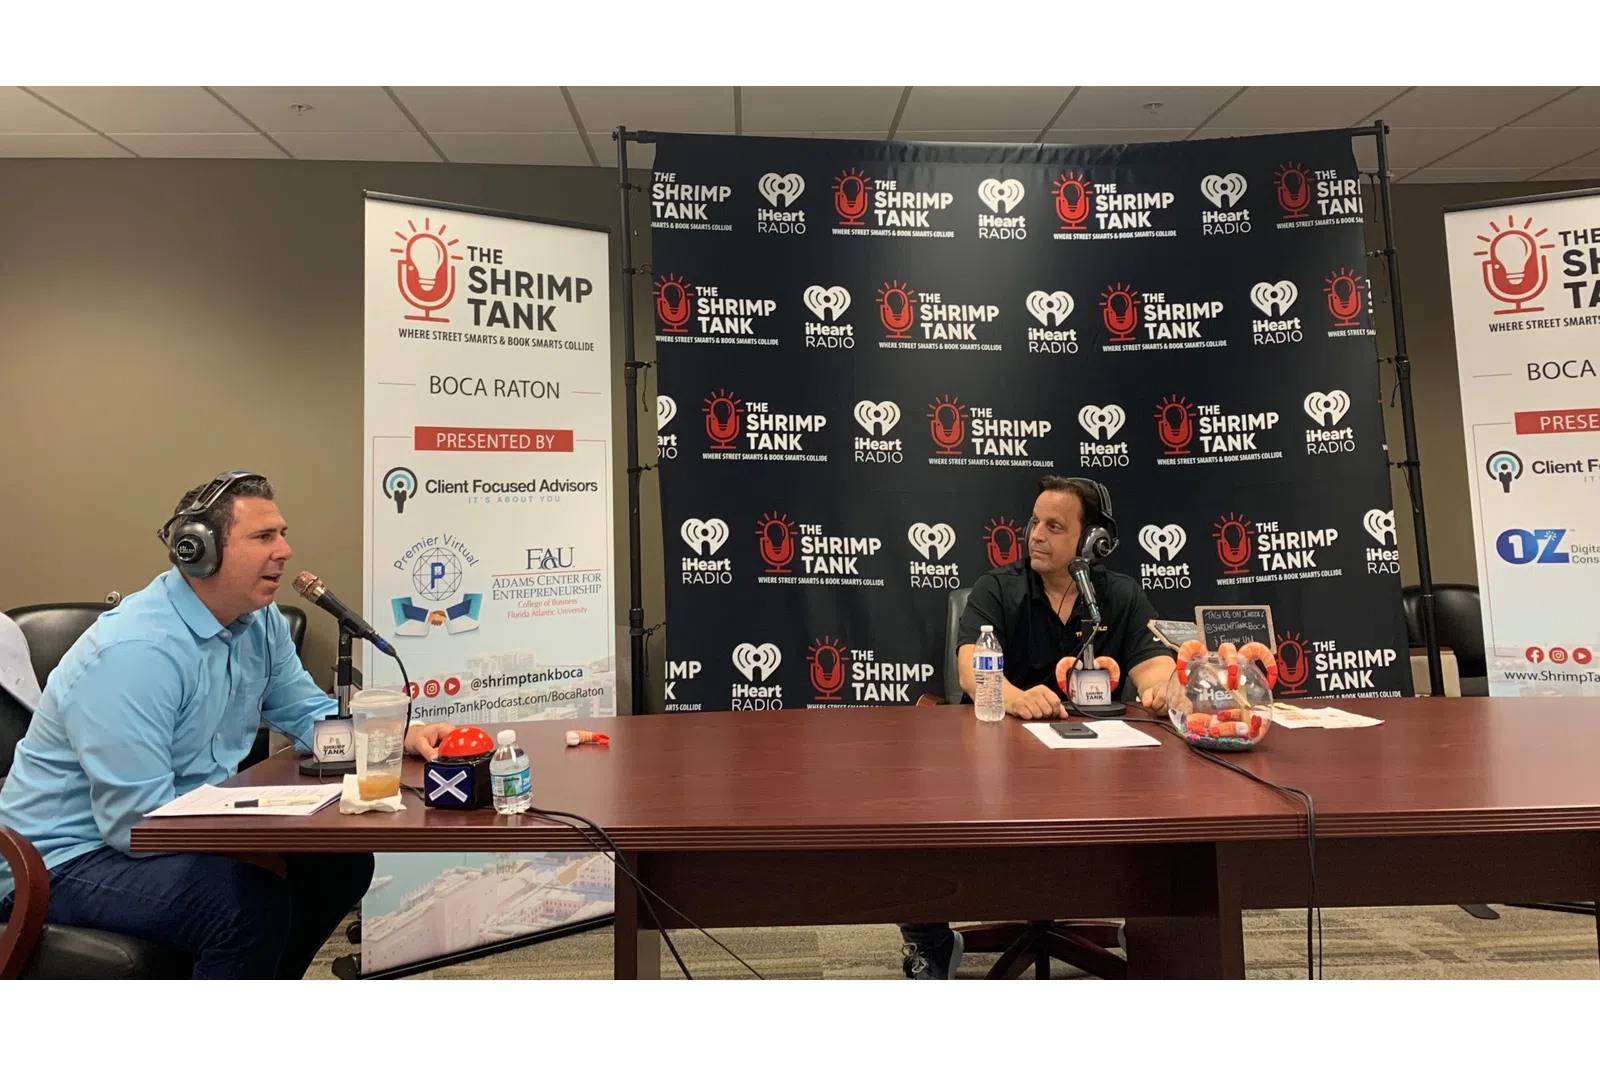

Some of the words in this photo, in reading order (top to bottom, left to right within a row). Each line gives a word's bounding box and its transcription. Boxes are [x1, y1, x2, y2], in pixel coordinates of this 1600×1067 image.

[654, 172, 675, 182] THE
[1315, 170, 1337, 180] THE
[875, 180, 896, 190] THE
[1094, 184, 1116, 193] THE
[653, 183, 731, 202] SHRIMP
[875, 191, 953, 209] SHRIMP
[1096, 193, 1174, 211] SHRIMP
[652, 202, 707, 220] TANK
[758, 208, 804, 222] iHeart
[1203, 209, 1249, 223] iHeart
[874, 210, 929, 227] TANK
[979, 214, 1025, 227] iHeart
[1096, 211, 1151, 229] TANK
[758, 222, 806, 234] RADIO
[979, 228, 1026, 239] RADIO
[1203, 222, 1251, 235] RADIO
[1053, 232, 1072, 240] WHERE
[1073, 232, 1092, 240] STREET
[1119, 231, 1133, 239] BOOK
[1558, 228, 1600, 247] THE
[467, 246, 502, 264] THE
[468, 266, 592, 303] SHRIMP
[696, 287, 718, 296] THE
[919, 293, 941, 303] THE
[1142, 293, 1164, 302] THE
[698, 298, 776, 316] SHRIMP
[921, 304, 999, 321] SHRIMP
[1144, 302, 1223, 321] SHRIMP
[468, 298, 556, 332] TANK
[698, 317, 753, 334] TANK
[806, 322, 853, 336] iHeart
[1145, 322, 1201, 339] TANK
[1253, 318, 1301, 332] iHeart
[1489, 321, 1524, 333] WHERE
[1526, 318, 1561, 330] STREET
[1563, 315, 1600, 327] SMARTS
[921, 323, 976, 340] TANK
[1028, 328, 1076, 341] iHeart
[1254, 330, 1302, 345] RADIO
[398, 328, 431, 340] WHERE
[432, 330, 463, 343] STREET
[464, 332, 498, 345] SMARTS
[499, 335, 506, 346] &
[507, 336, 531, 347] BOOK
[531, 337, 563, 350] SMARTS
[564, 340, 594, 352] COLLIDE
[806, 336, 854, 348] RADIO
[1029, 341, 1078, 353] RADIO
[1527, 359, 1597, 381] BOCA
[430, 375, 488, 397] BOCA
[494, 380, 560, 400] RATON
[746, 403, 768, 412] THE
[970, 408, 992, 417] THE
[1198, 405, 1220, 415] THE
[747, 414, 826, 431] SHRIMP
[972, 419, 1051, 437] SHRIMP
[1200, 412, 1279, 433] SHRIMP
[436, 432, 531, 449] PRESENTED
[535, 435, 555, 450] BY
[747, 433, 802, 450] TANK
[1306, 427, 1353, 442] iHeart
[855, 437, 901, 450] iHeart
[972, 438, 1028, 456] TANK
[1080, 442, 1127, 454] iHeart
[1200, 433, 1256, 452] TANK
[1307, 440, 1355, 454] RADIO
[742, 453, 763, 461] SMARTS
[855, 451, 903, 463] RADIO
[1081, 455, 1129, 467] RADIO
[1532, 460, 1583, 474] Client
[425, 479, 469, 494] Client
[473, 479, 536, 493] Focused
[539, 478, 598, 493] Advisors
[468, 496, 491, 504] IT'S
[497, 495, 533, 504] ABOUT
[540, 495, 561, 503] YOU
[800, 525, 822, 534] THE
[1256, 522, 1278, 533] THE
[801, 536, 881, 555] SHRIMP
[1258, 529, 1338, 551] SHRIMP
[394, 536, 439, 571] Premier
[443, 533, 480, 567] Virtual
[525, 547, 575, 570] FAU
[683, 558, 731, 570] iHeart
[802, 556, 858, 574] TANK
[1258, 550, 1316, 571] TANK
[910, 561, 958, 575] iHeart
[1141, 563, 1189, 576] iHeart
[431, 562, 445, 590] P
[492, 577, 535, 589] ADAMS
[537, 574, 580, 586] CENTER
[582, 573, 602, 583] FOR
[683, 572, 732, 584] RADIO
[911, 576, 960, 588] RADIO
[1142, 576, 1191, 589] RADIO
[1216, 578, 1236, 586] WHERE
[1236, 576, 1255, 585] STREET
[1255, 574, 1278, 583] SMARTS
[1284, 572, 1299, 581] BOOK
[1299, 571, 1321, 580] SMARTS
[1321, 568, 1343, 578] COLLIDE
[492, 583, 602, 601] ENTREPRENEURSHIP
[518, 600, 542, 609] College
[552, 598, 578, 606] Business
[507, 610, 530, 619] Florida
[531, 608, 555, 617] Atlantic
[557, 606, 587, 616] University
[1313, 641, 1336, 652] THE
[851, 650, 873, 660] THE
[1315, 649, 1396, 671] SHRIMP
[853, 662, 934, 681] SHRIMP
[470, 668, 583, 690] @shrimptankboca
[1316, 670, 1374, 691] TANK
[733, 684, 781, 697] iHeart
[852, 683, 909, 701] TANK
[1380, 690, 1402, 698] COLLIDE
[680, 703, 702, 711] COLLIDE
[732, 699, 782, 711] RADIO
